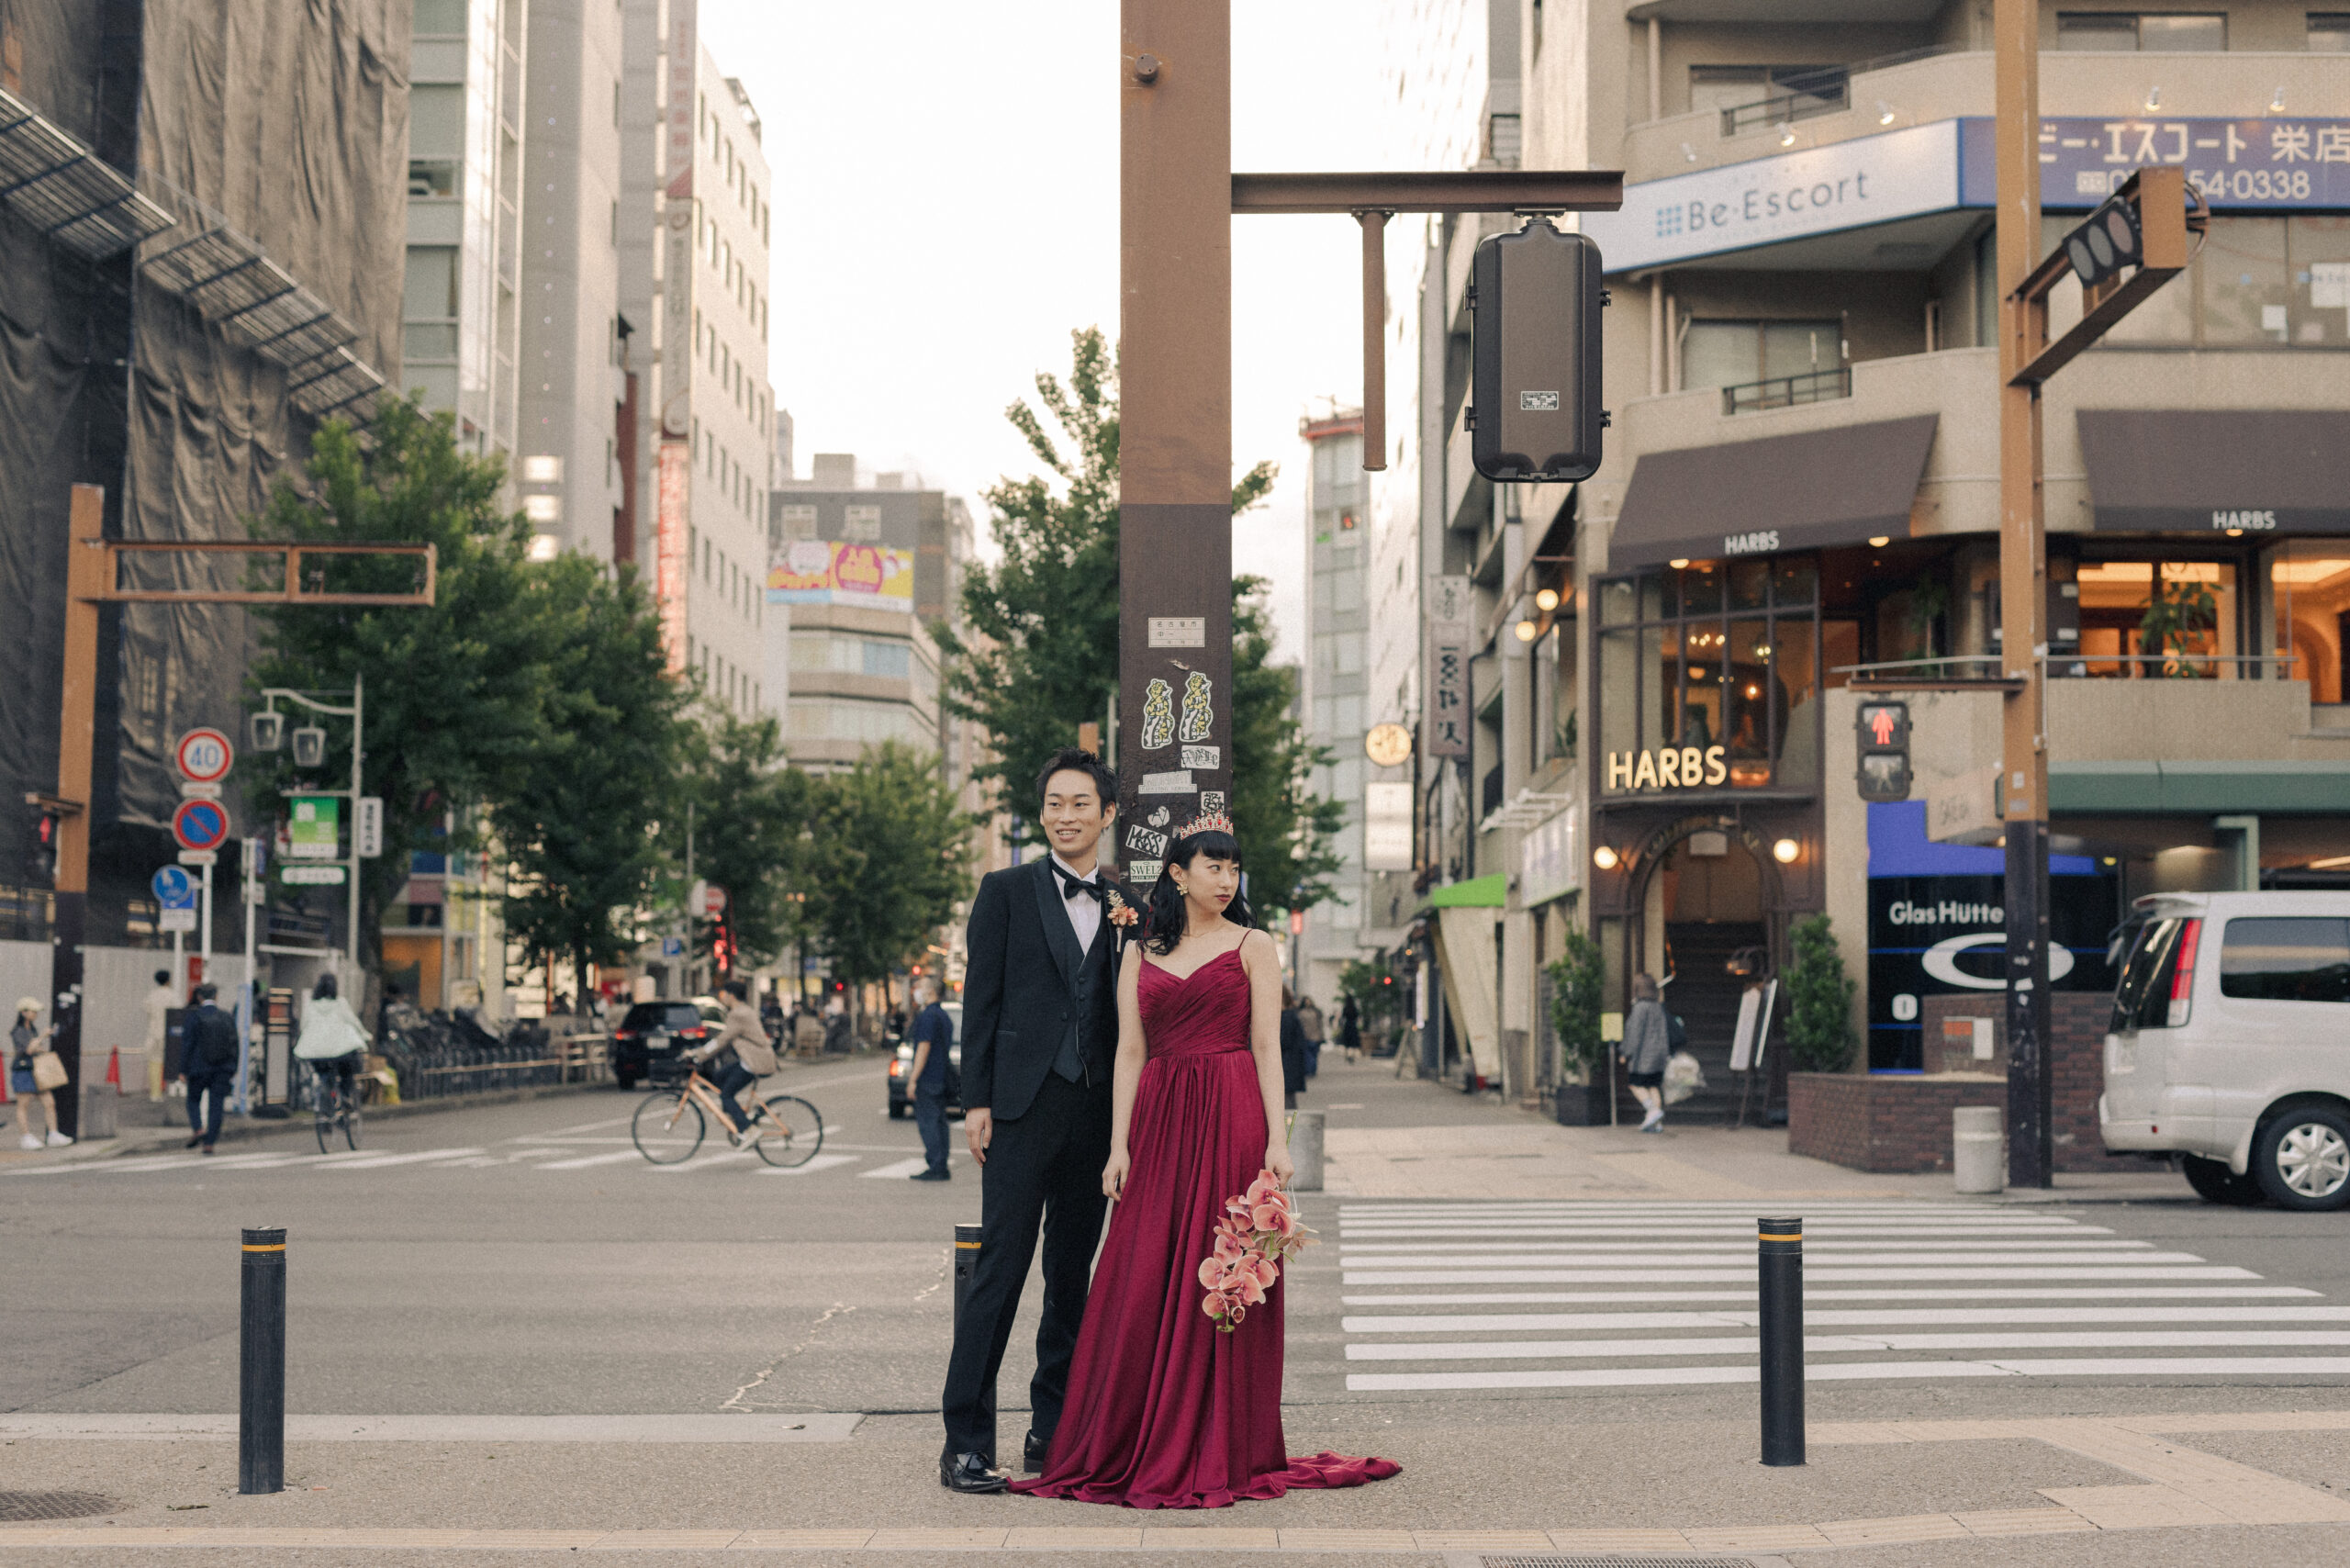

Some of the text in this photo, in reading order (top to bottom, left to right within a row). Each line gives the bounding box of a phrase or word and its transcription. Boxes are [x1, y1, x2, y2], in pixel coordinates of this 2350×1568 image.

[2212, 510, 2276, 530] HARBS
[1725, 530, 1780, 555] HARBS
[190, 744, 219, 768] 40
[1608, 745, 1727, 790] HARBS
